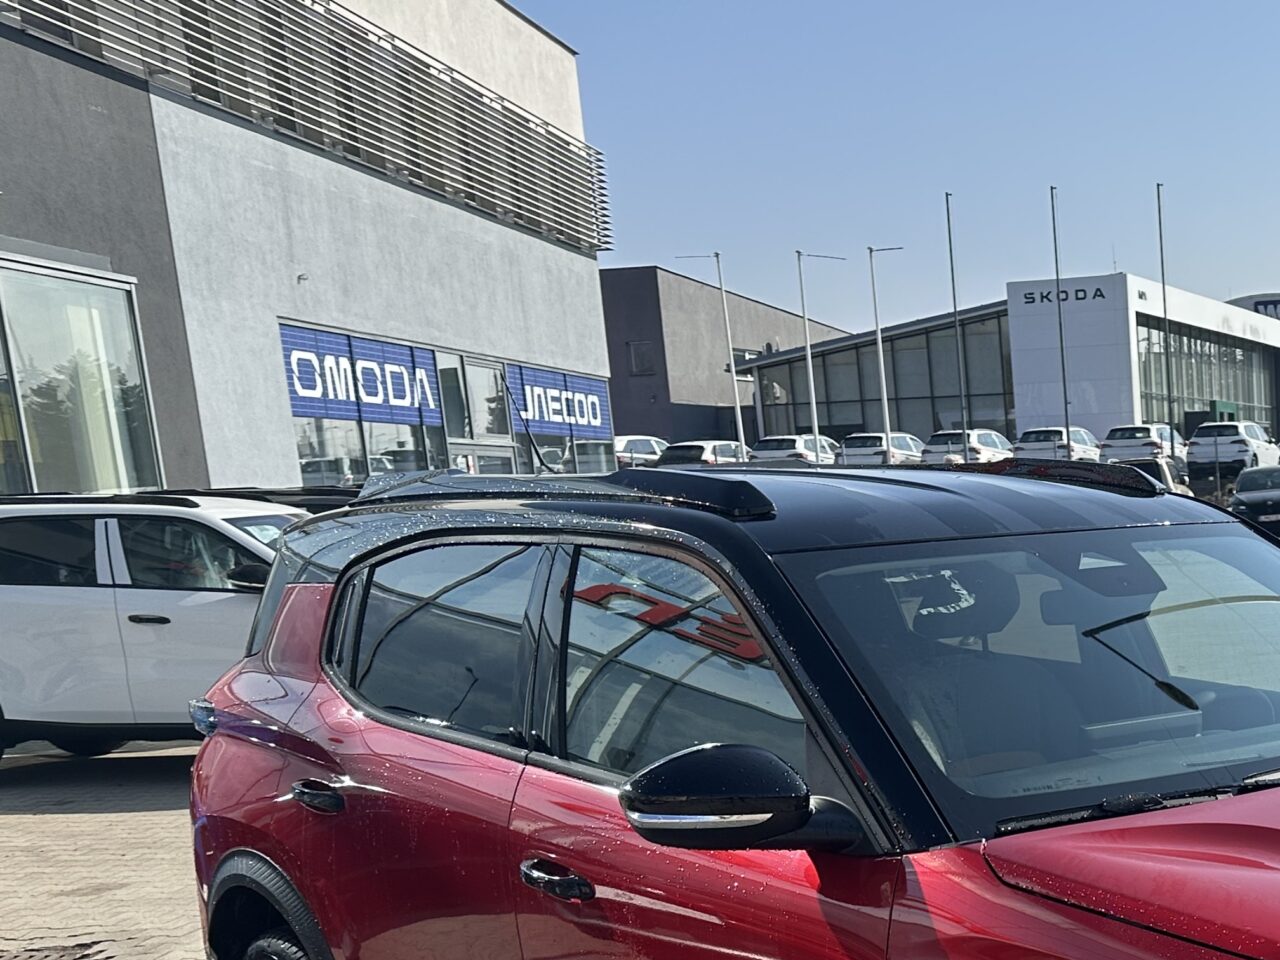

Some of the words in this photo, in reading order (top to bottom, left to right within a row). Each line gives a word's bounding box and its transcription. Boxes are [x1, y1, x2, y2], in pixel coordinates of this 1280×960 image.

[1024, 288, 1106, 305] SKODA
[290, 350, 436, 409] OMODA
[520, 385, 602, 427] JAECOO
